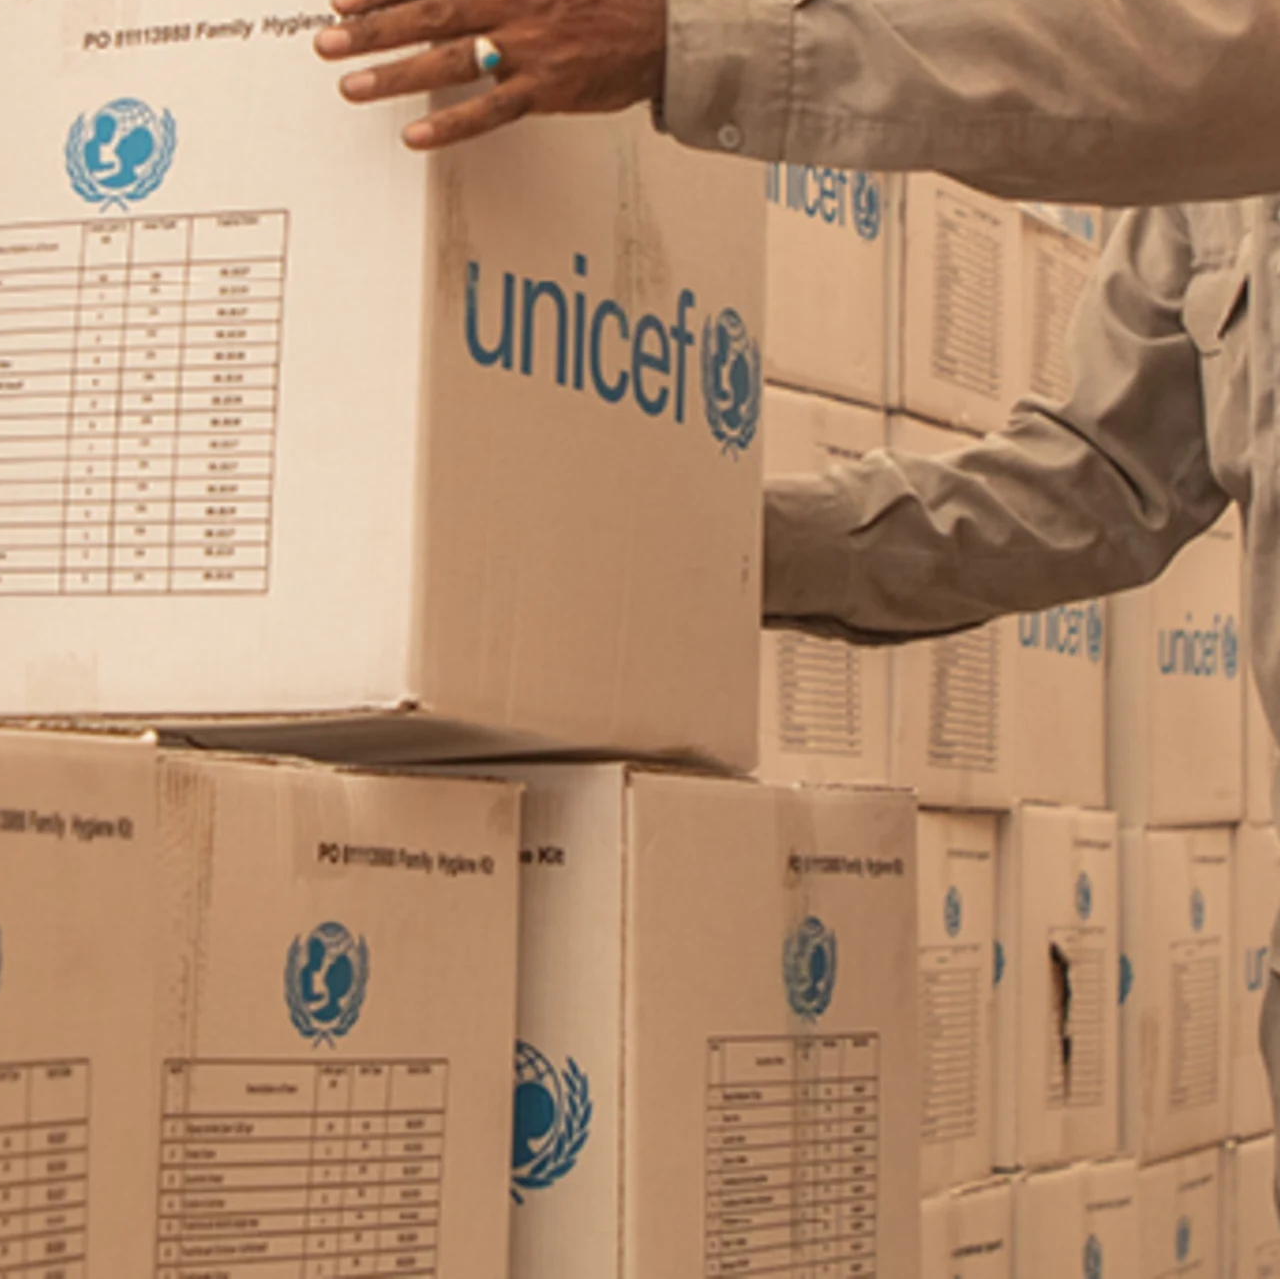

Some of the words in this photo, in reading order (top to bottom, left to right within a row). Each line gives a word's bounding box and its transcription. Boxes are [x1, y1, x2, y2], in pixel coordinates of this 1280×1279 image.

[82, 30, 112, 51] PO
[194, 17, 256, 40] Family
[262, 9, 337, 38] Hygiene
[463, 252, 696, 425] unicef
